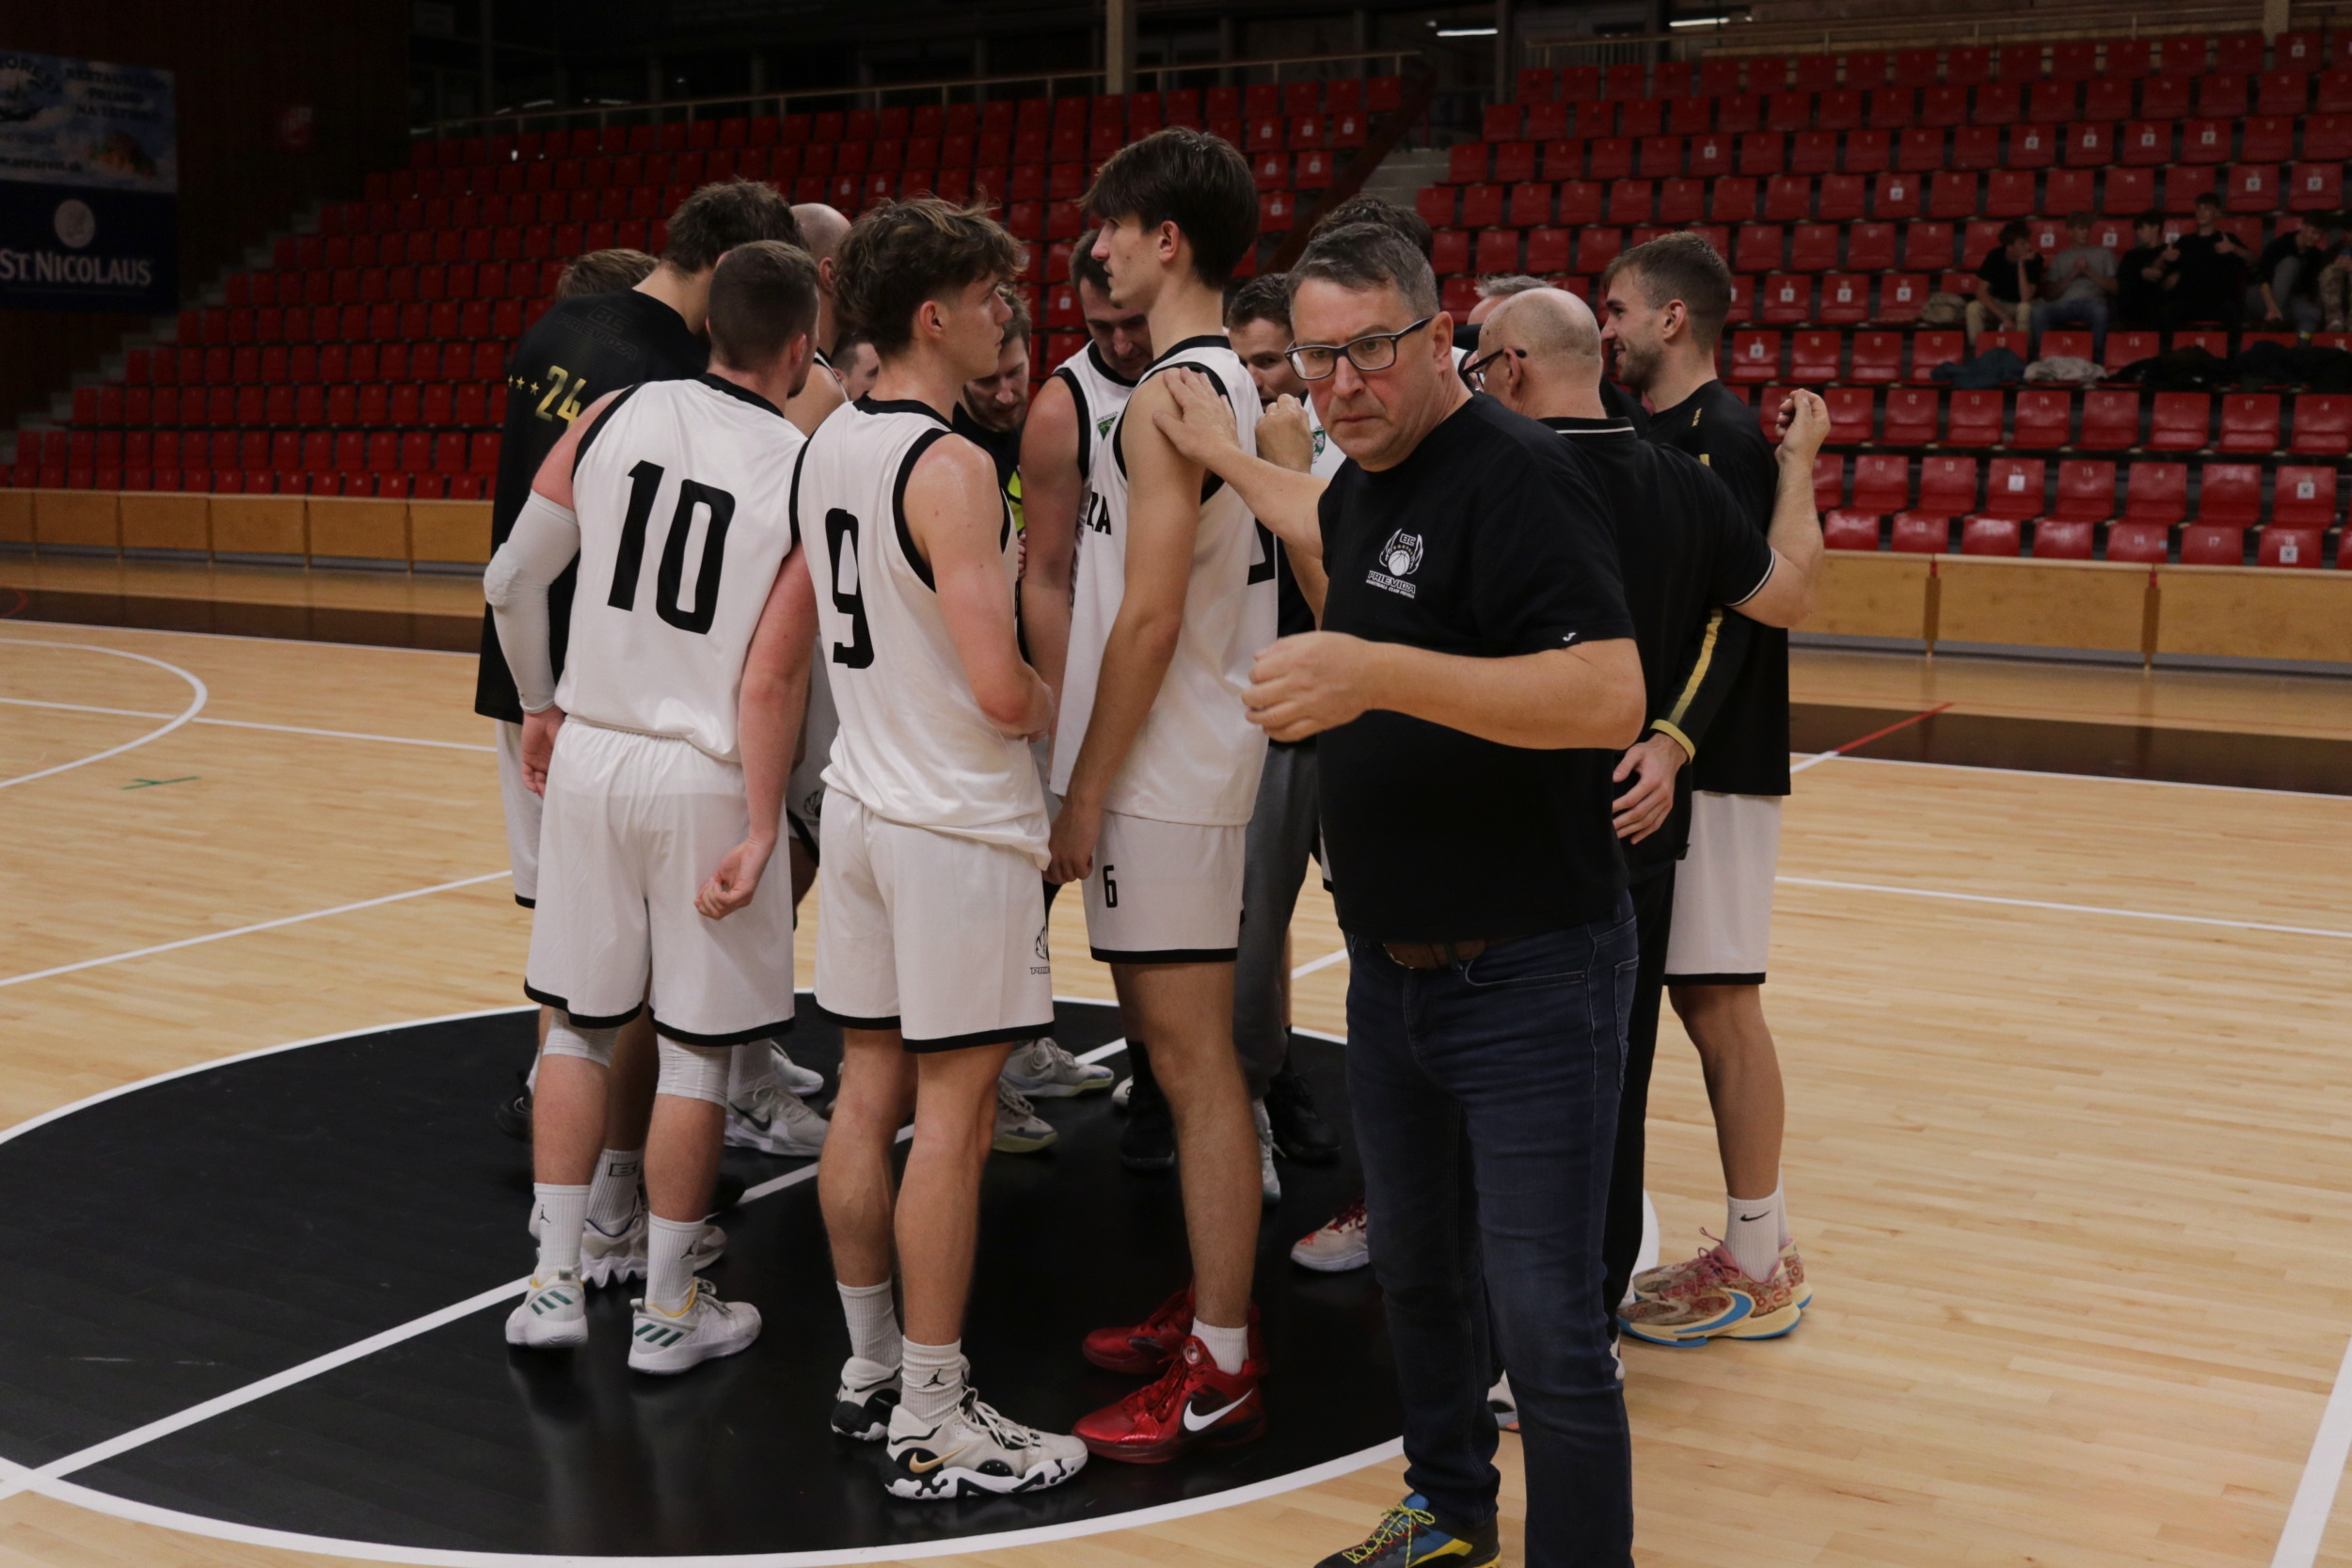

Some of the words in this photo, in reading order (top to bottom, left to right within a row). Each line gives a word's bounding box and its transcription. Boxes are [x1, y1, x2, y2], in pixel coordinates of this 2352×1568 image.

[35, 251, 152, 286] NICOLAUS
[557, 311, 639, 361] PRIEVIDZA
[587, 304, 633, 334] BC
[534, 365, 587, 429] 24
[607, 459, 736, 635] 10
[1400, 533, 1416, 546] BC
[824, 506, 876, 670] 9
[1368, 570, 1416, 594] PRIEVIDZA
[1102, 863, 1119, 910] 6
